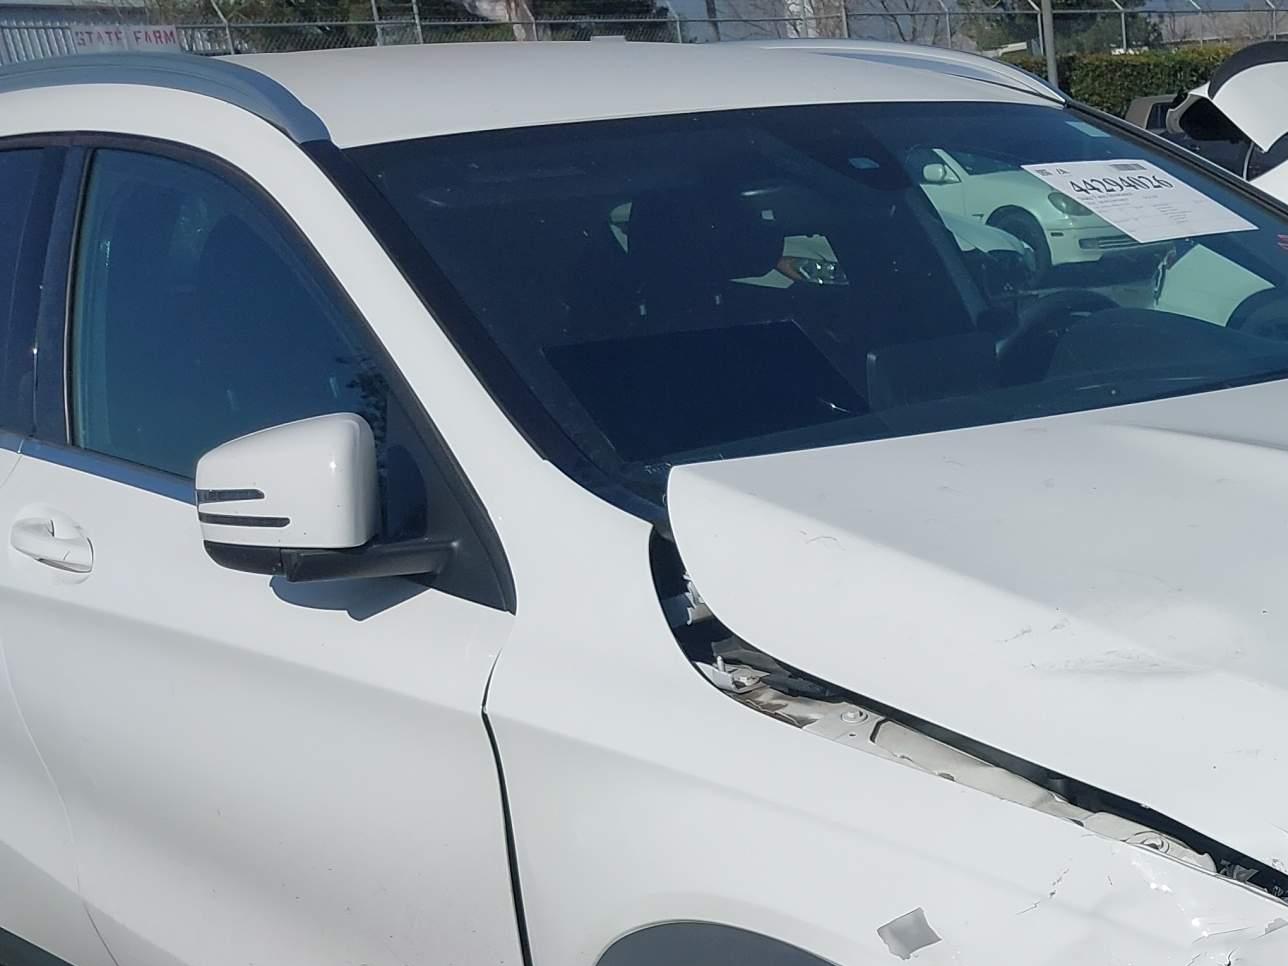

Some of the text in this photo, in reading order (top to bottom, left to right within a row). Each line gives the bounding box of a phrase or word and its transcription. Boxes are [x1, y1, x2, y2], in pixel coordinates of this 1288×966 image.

[77, 29, 176, 46] STATE FARM
[1069, 175, 1174, 195] 44294026
